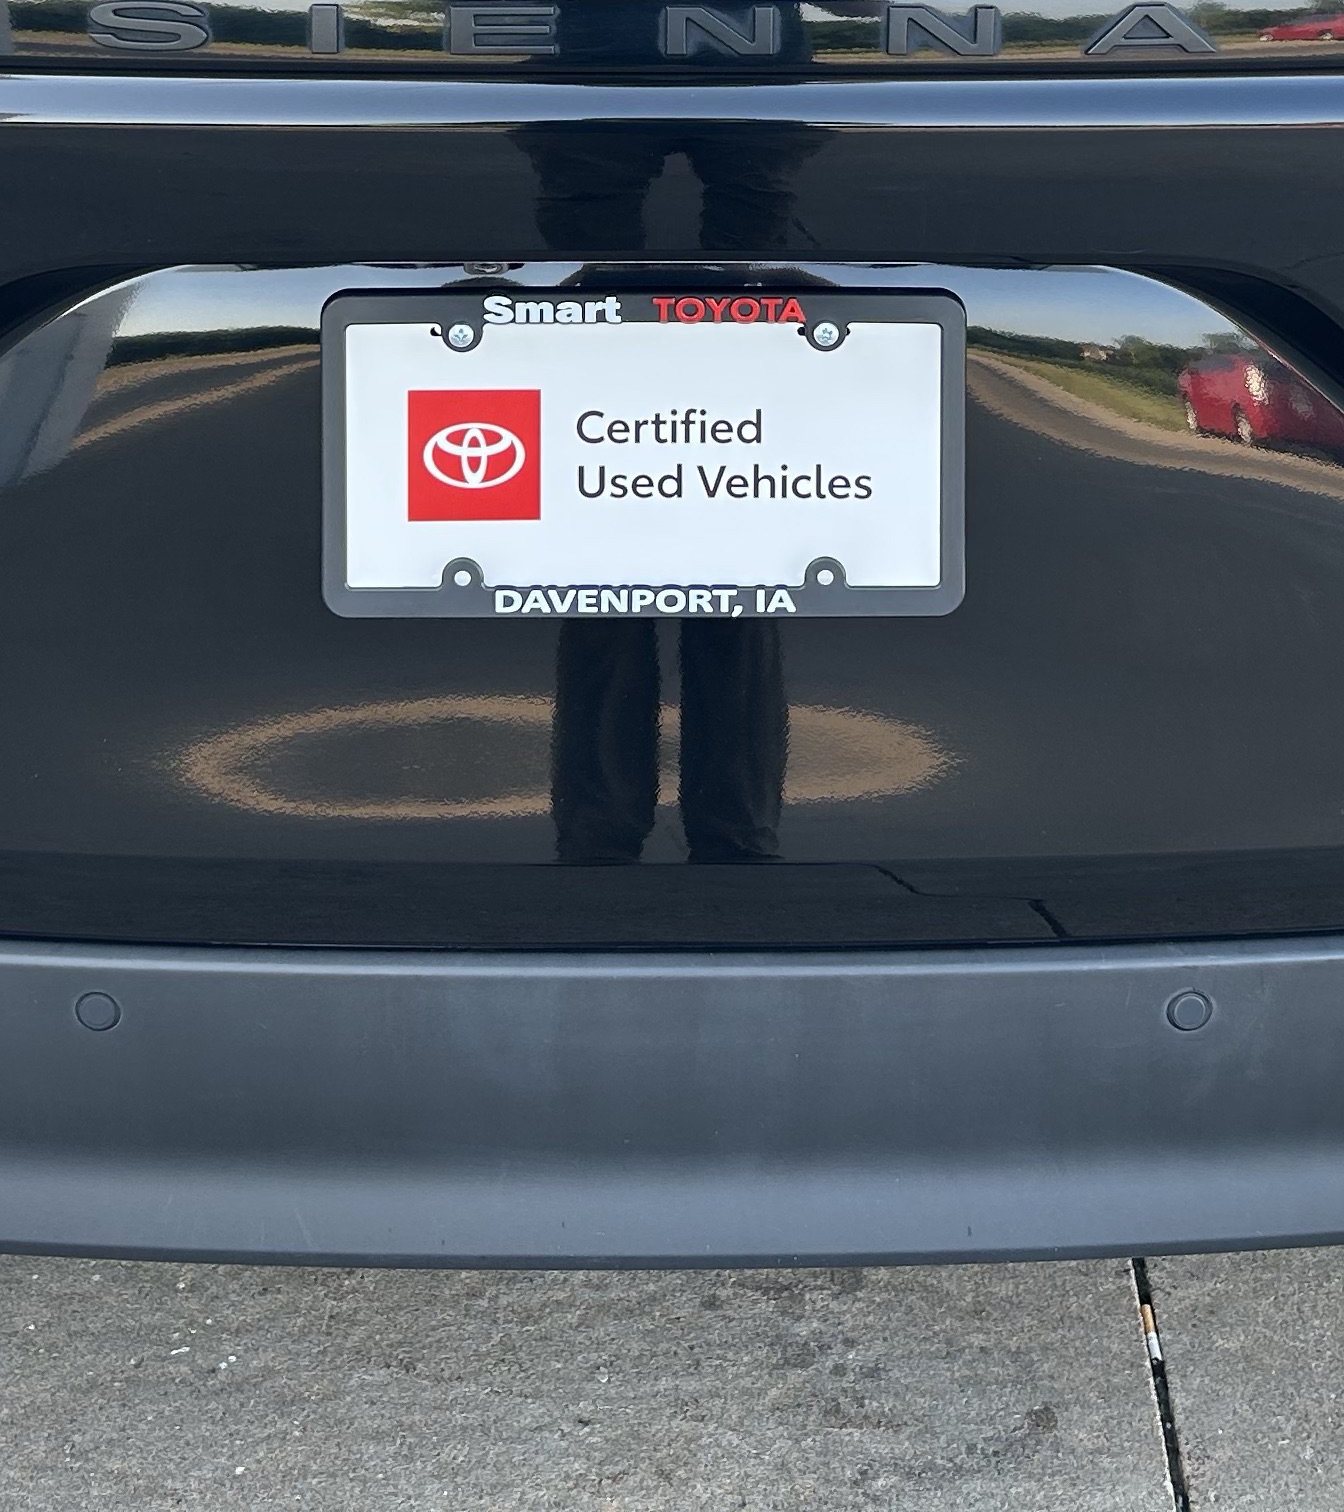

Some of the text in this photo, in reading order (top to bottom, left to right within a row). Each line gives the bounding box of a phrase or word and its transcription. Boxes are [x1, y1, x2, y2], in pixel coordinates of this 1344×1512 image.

[87, 0, 1218, 55] SIENNA
[483, 296, 807, 324] Smart TOYOTA
[575, 408, 763, 445] Certified
[576, 464, 873, 500] Used Vehicles
[494, 588, 798, 618] DAVENPORT, IA
